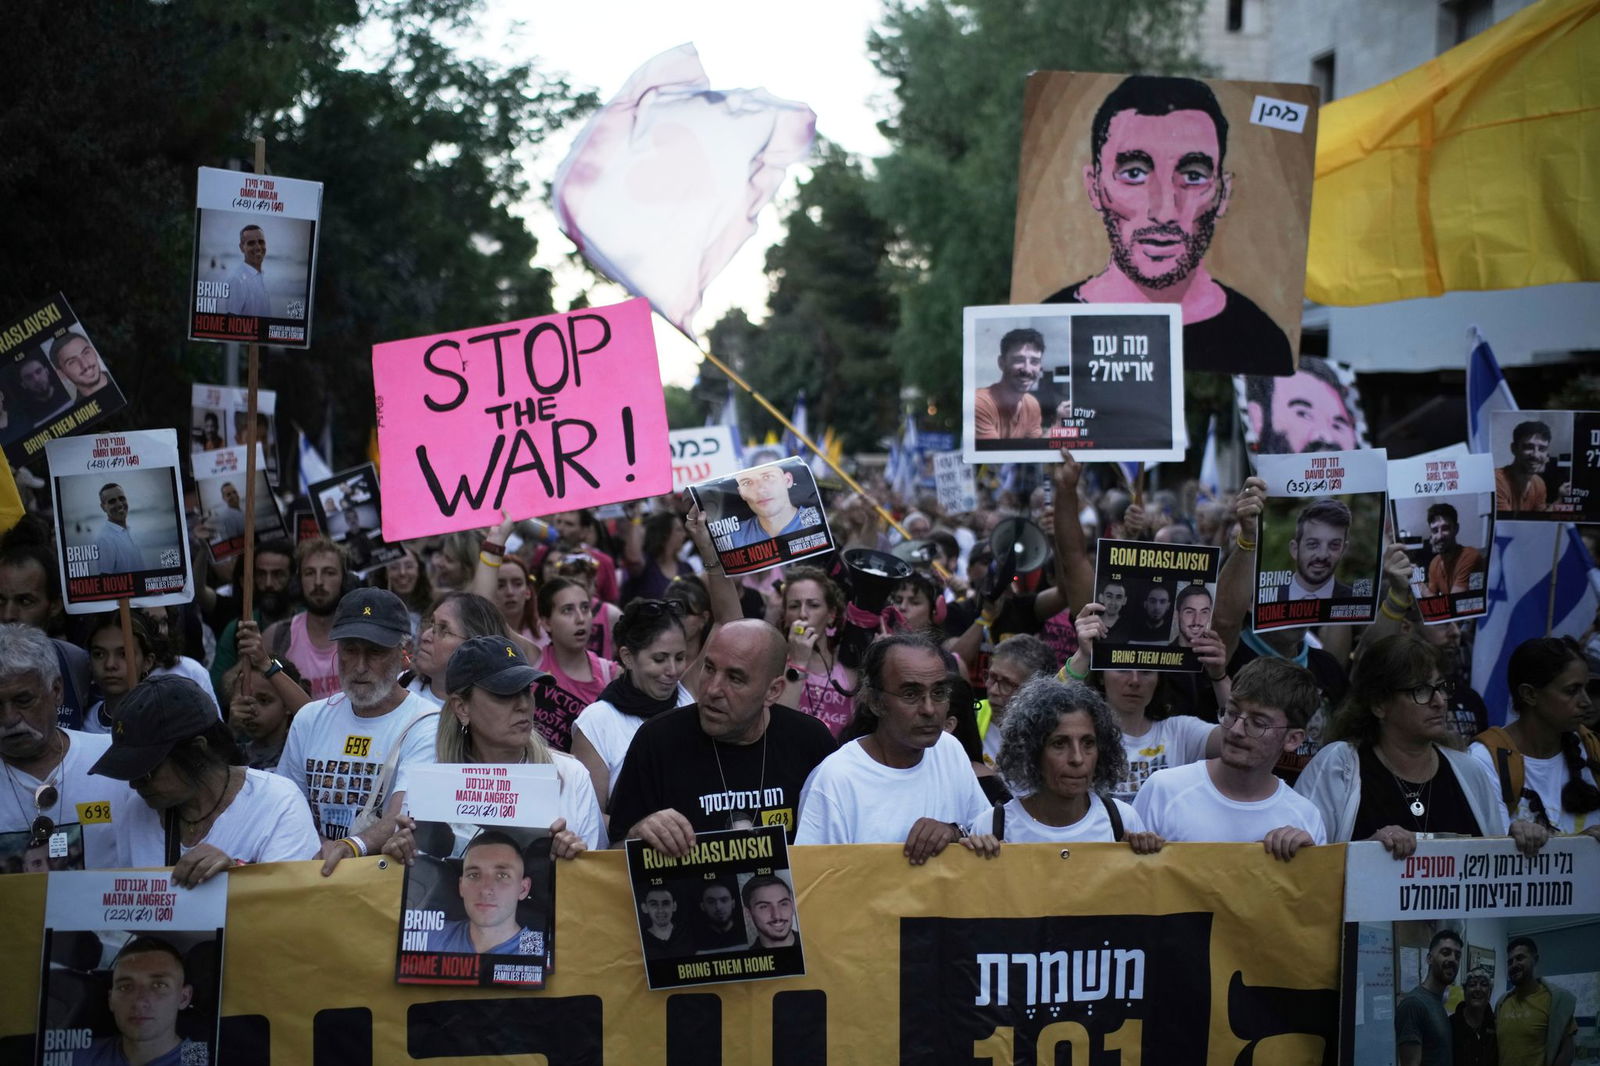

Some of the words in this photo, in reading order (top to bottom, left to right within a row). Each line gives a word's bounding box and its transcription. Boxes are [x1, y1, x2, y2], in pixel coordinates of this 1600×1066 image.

[1258, 103, 1299, 123] מתן
[240, 188, 256, 198] OMRI
[258, 190, 278, 200] MIRAN
[197, 281, 230, 299] BRING
[196, 297, 218, 314] HIM
[0, 302, 62, 354] RASLAVSKI
[195, 315, 225, 331] HOME
[228, 316, 259, 335] NOW!
[423, 313, 612, 412] STOP
[1088, 359, 1154, 382] אריאל?
[484, 396, 558, 429] THE
[1073, 408, 1096, 418] לעולם
[1076, 418, 1085, 427] לא
[23, 430, 52, 455] BRING
[49, 415, 78, 438] THEM
[74, 400, 102, 425] HOME
[92, 448, 109, 458] OMRI
[110, 446, 132, 456] MIRAN
[1305, 469, 1324, 480] DAVID
[1326, 468, 1345, 478] CUNIO
[708, 516, 740, 537] BRING
[67, 544, 99, 562] BRING
[714, 535, 735, 552] HIM
[721, 549, 748, 567] HOME
[748, 538, 779, 563] NOW!
[1110, 547, 1137, 566] ROM
[1138, 549, 1210, 571] BRASLAVSKI
[69, 561, 90, 578] HIM
[1259, 570, 1293, 587] BRING
[70, 576, 100, 595] HOME
[103, 573, 135, 592] NOW!
[1258, 587, 1279, 604] HIM
[1257, 603, 1286, 622] HOME
[1288, 599, 1320, 618] NOW!
[1111, 650, 1136, 663] BRING
[1137, 651, 1160, 664] THEM
[1160, 652, 1184, 665] HOME
[544, 685, 588, 716] VICTO
[535, 708, 570, 733] HOSTA
[345, 737, 370, 756] 698
[466, 777, 495, 790] אנגרסט
[496, 779, 511, 792] מתן
[456, 789, 482, 802] MATAN
[484, 791, 519, 804] ANGREST
[699, 790, 761, 816] ברסלבסקי
[764, 787, 784, 807] רום
[85, 805, 111, 819] 698
[768, 812, 788, 825] 698
[1400, 856, 1455, 879] חטופים.
[1494, 854, 1523, 878] ברמן
[1554, 852, 1573, 874] גלי
[115, 879, 148, 892] אנגרסט
[151, 879, 167, 893] מתן
[1526, 881, 1573, 907] תמונת
[103, 893, 133, 906] MATAN
[136, 893, 176, 906] ANGREST
[1400, 884, 1460, 911] המוחלט
[1465, 883, 1522, 912] הניצחון
[404, 910, 445, 930] BRING
[402, 931, 428, 951] HIM
[400, 954, 437, 975] HOME
[441, 955, 480, 977] NOW!
[678, 962, 711, 979] BRING
[712, 959, 742, 976] THEM
[744, 955, 775, 974] HOME
[493, 971, 520, 982] FAMILIES
[521, 972, 542, 983] FORUM
[44, 1028, 93, 1050] BRING
[43, 1051, 73, 1066] HIM
